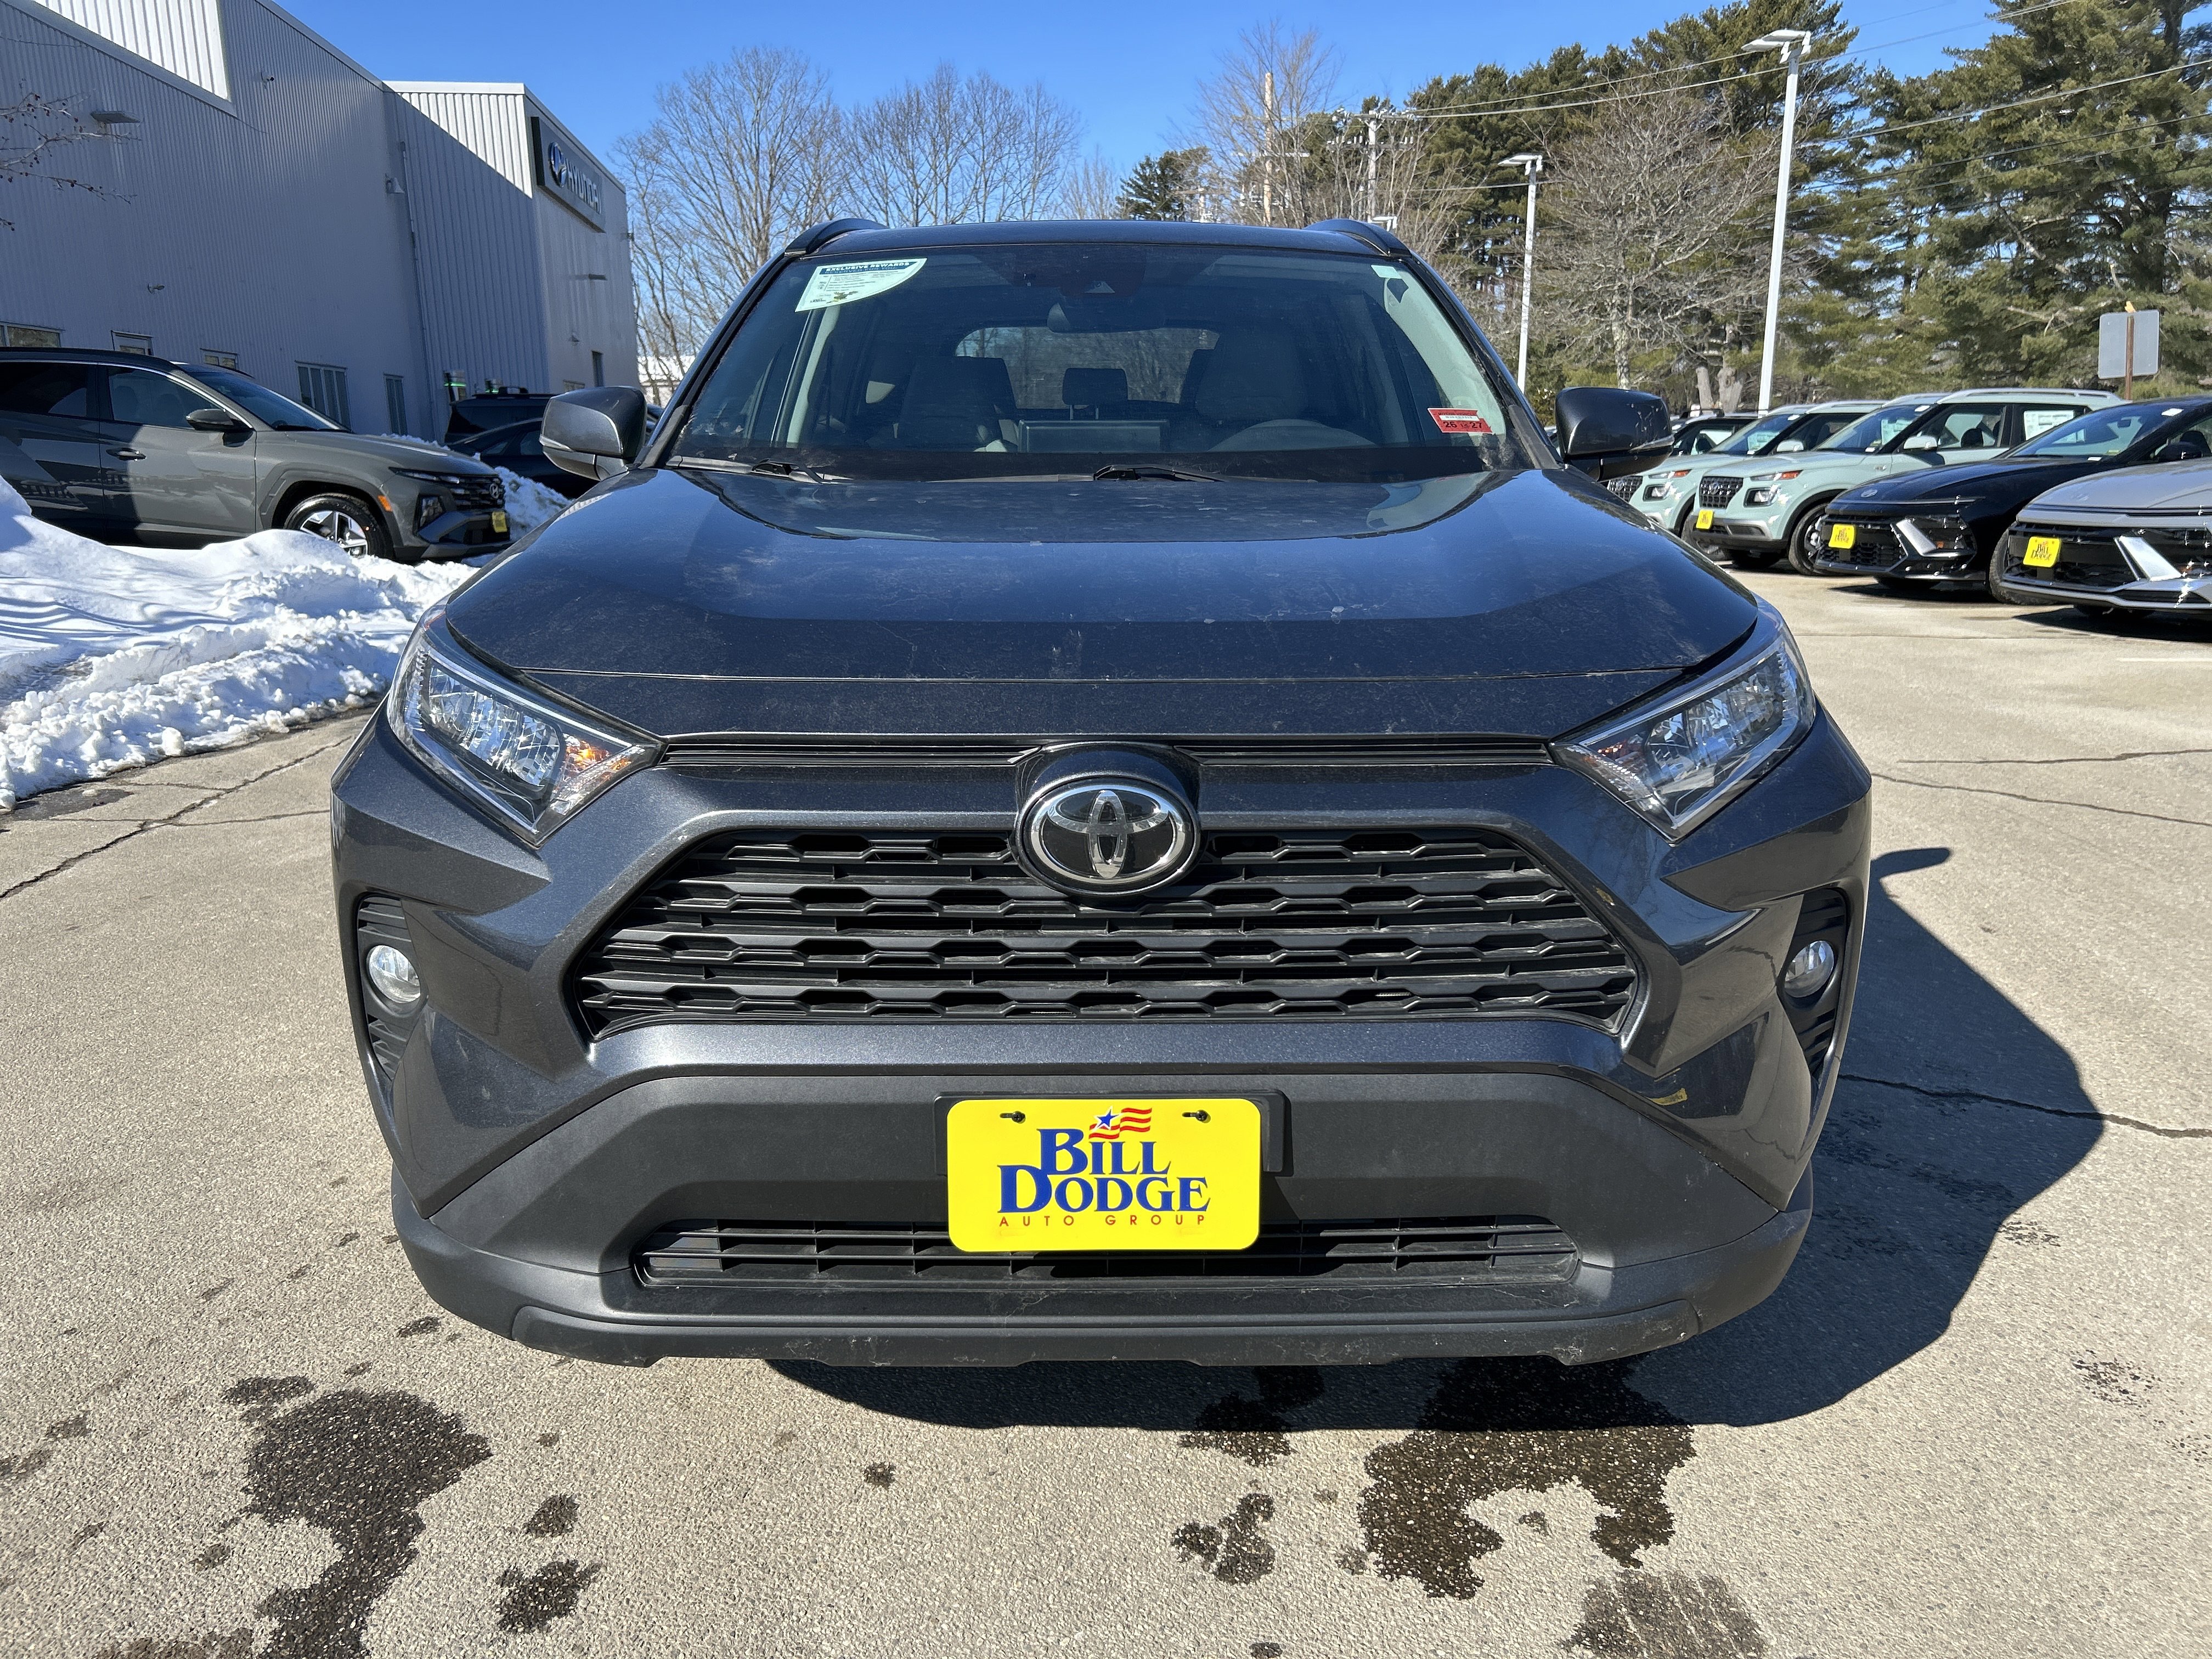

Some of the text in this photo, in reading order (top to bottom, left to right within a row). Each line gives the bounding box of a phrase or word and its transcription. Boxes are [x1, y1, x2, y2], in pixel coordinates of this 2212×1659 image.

[565, 158, 602, 215] HYUNDAI
[1037, 1128, 1171, 1175] BILL
[997, 1164, 1211, 1213] DODGE
[998, 1214, 1204, 1227] AUTO GROUP
